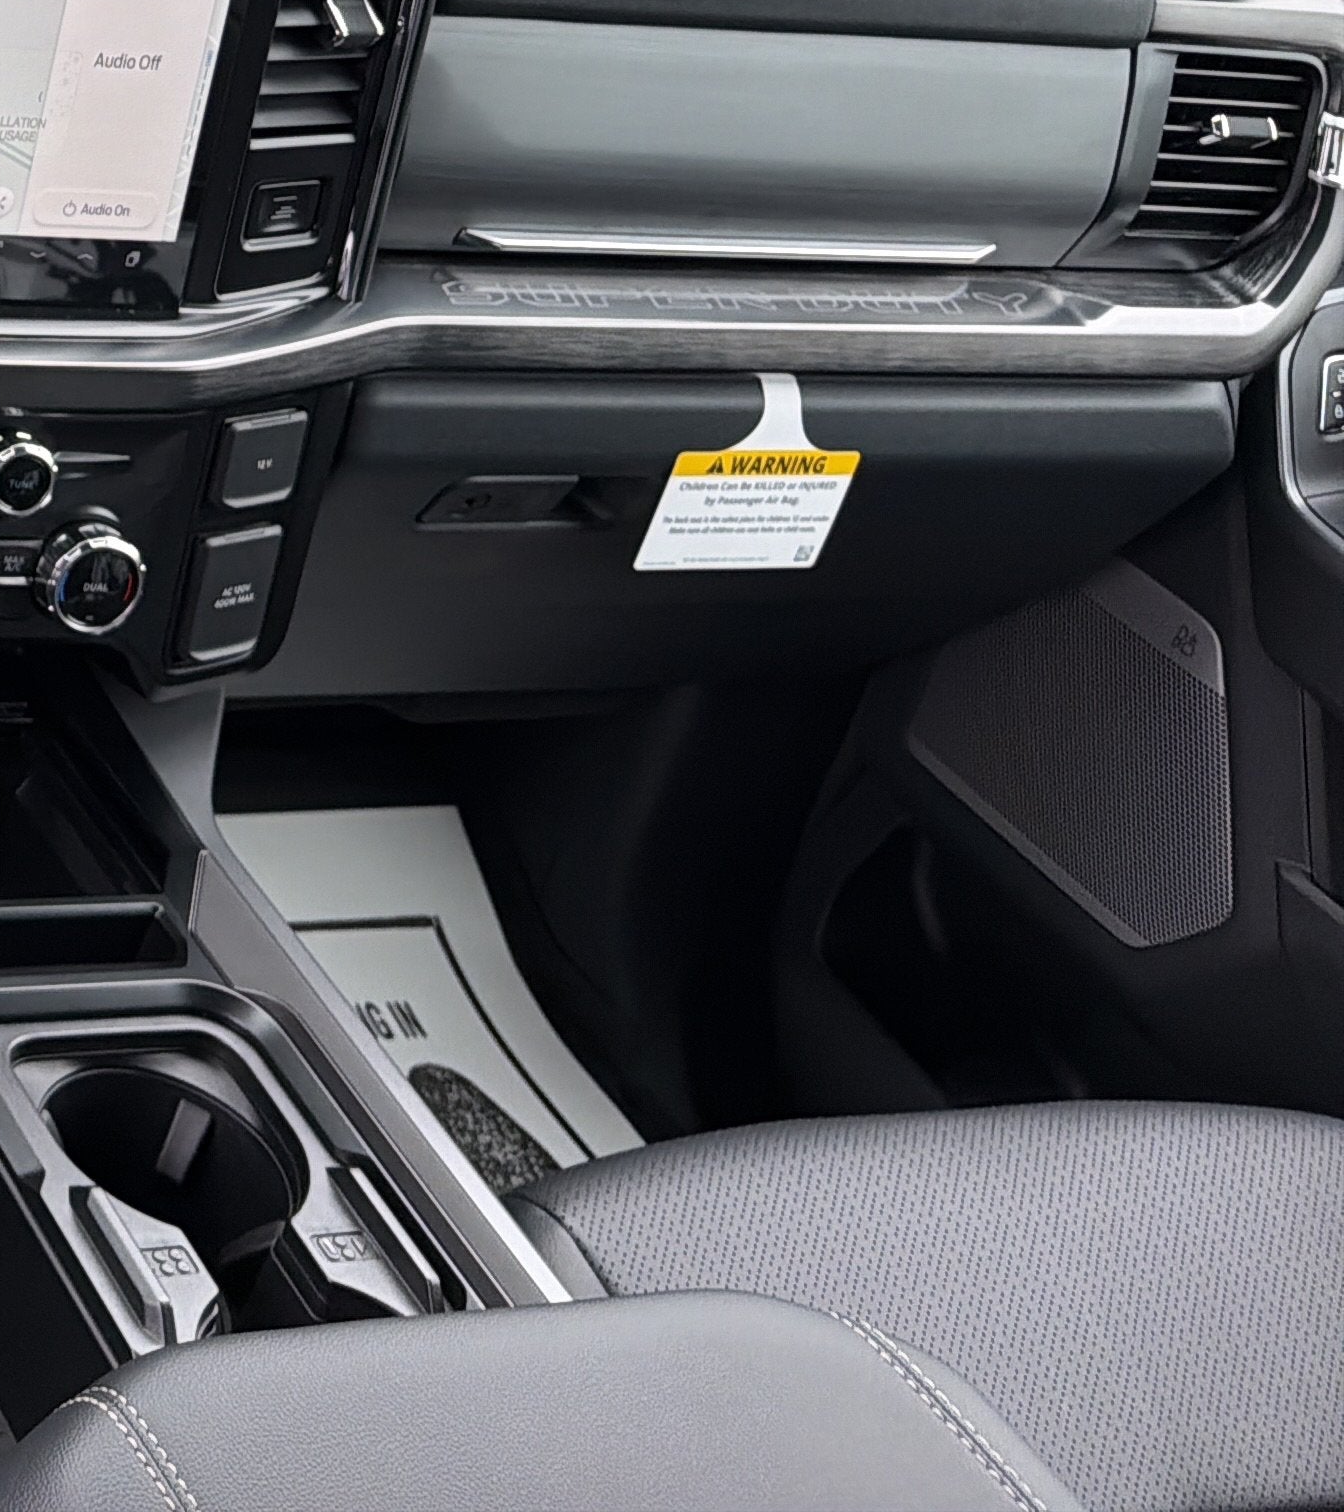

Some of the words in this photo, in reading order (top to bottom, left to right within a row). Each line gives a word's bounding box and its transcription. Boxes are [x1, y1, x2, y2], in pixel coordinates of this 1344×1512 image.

[94, 52, 136, 70] Audio
[139, 54, 162, 71] Off
[80, 203, 112, 216] Audio
[113, 205, 131, 217] On
[730, 455, 828, 475] WARNING
[679, 481, 719, 491] Children
[721, 481, 739, 491] Can
[82, 583, 109, 593] DUAL
